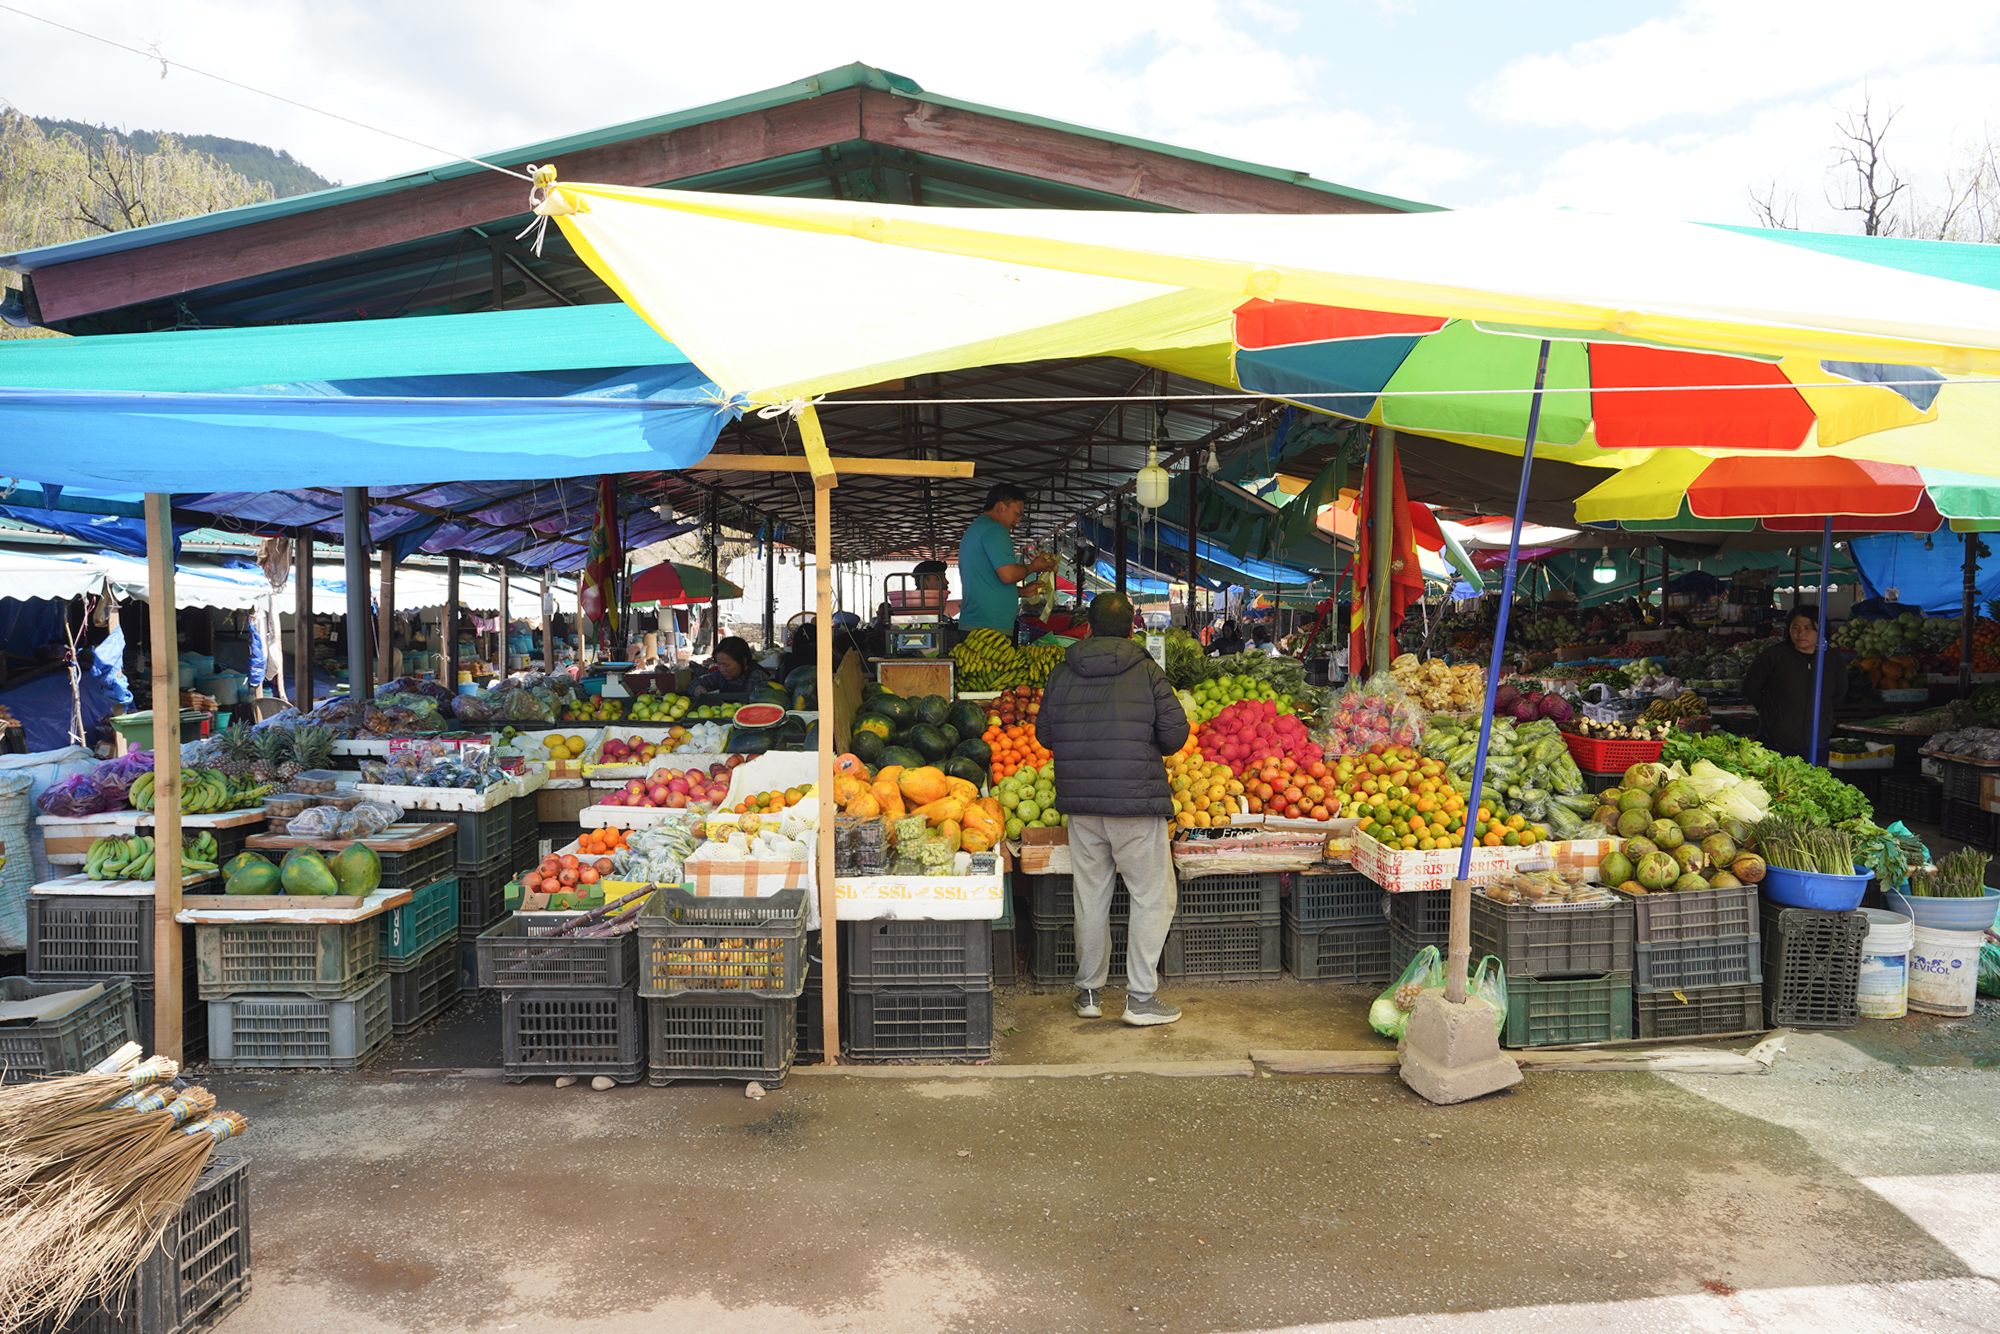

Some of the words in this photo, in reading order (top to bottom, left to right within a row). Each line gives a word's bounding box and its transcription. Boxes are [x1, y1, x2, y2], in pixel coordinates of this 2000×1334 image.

[1414, 863, 1457, 875] SRISTI
[1470, 859, 1510, 873] SRISTI
[1414, 878, 1450, 890] SRIST
[878, 885, 912, 899] SSL
[932, 886, 968, 900] SSL
[1909, 960, 1950, 975] FEVICOL
